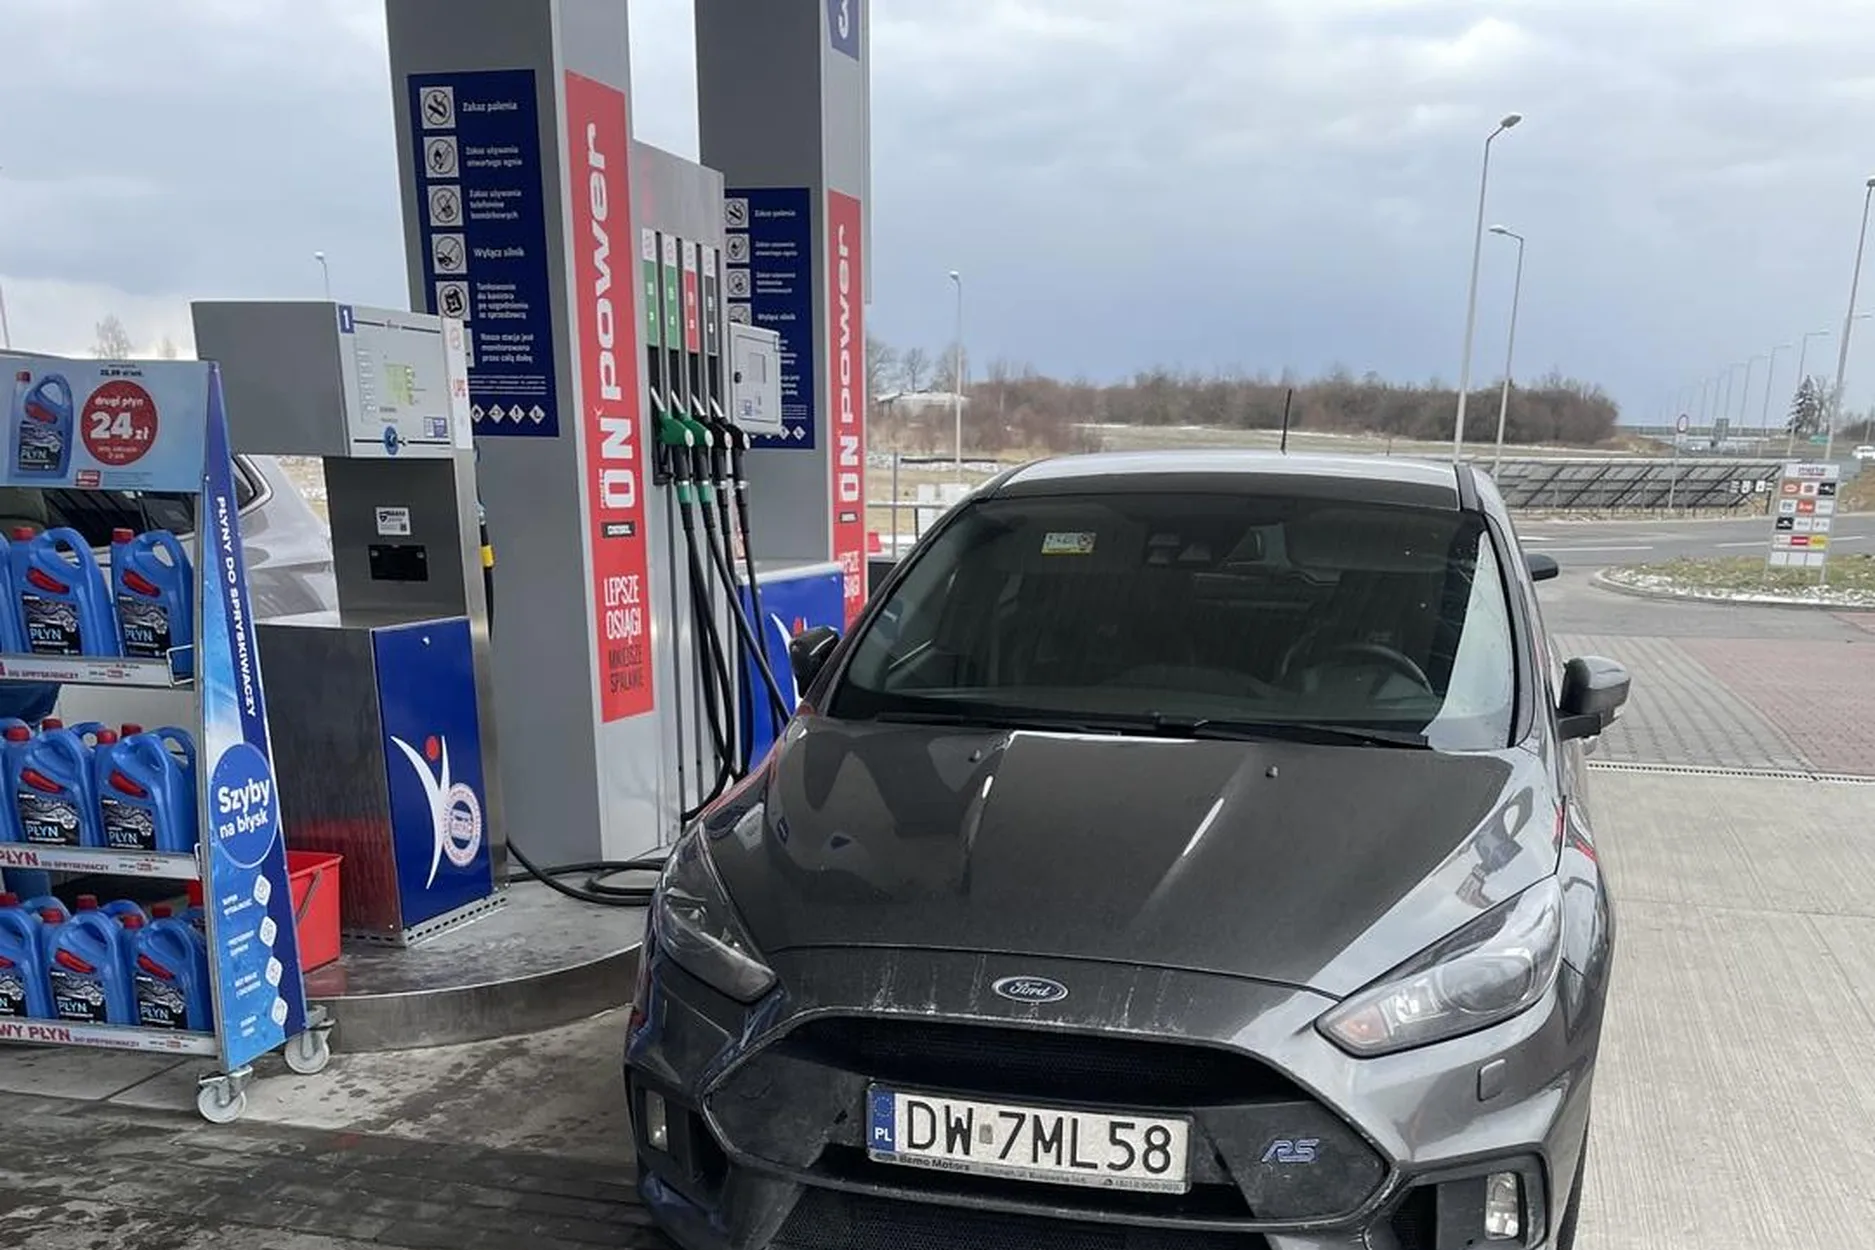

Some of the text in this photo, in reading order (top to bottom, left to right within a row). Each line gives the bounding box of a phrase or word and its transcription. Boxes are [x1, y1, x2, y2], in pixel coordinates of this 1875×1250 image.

[462, 101, 518, 113] Zakaz palenia
[473, 247, 525, 260] Wyłącz silnik
[342, 308, 350, 331] 1
[586, 121, 636, 509] ON power
[836, 223, 854, 425] power
[121, 396, 145, 409] płyn
[90, 411, 149, 441] 24 zł
[839, 435, 859, 502] ON
[604, 574, 640, 607] LEPSZE
[217, 496, 255, 718] PŁYNY DO SPRYSKIWACZY
[29, 628, 62, 641] PŁYN
[124, 627, 154, 642] PŁYN
[606, 607, 642, 645] OSIĄGI
[218, 778, 270, 814] Szyby
[26, 824, 60, 838] PŁYN
[220, 807, 268, 839] na błysk
[108, 830, 138, 844] PŁYN
[1009, 979, 1051, 997] Ford
[58, 999, 88, 1013] PŁYN
[140, 1005, 169, 1021] PŁYN
[28, 1026, 72, 1042] PŁYN
[874, 1127, 893, 1142] PL
[906, 1099, 1172, 1175] DW 7ML58
[1261, 1138, 1320, 1163] RS
[931, 1158, 971, 1172] Motors
